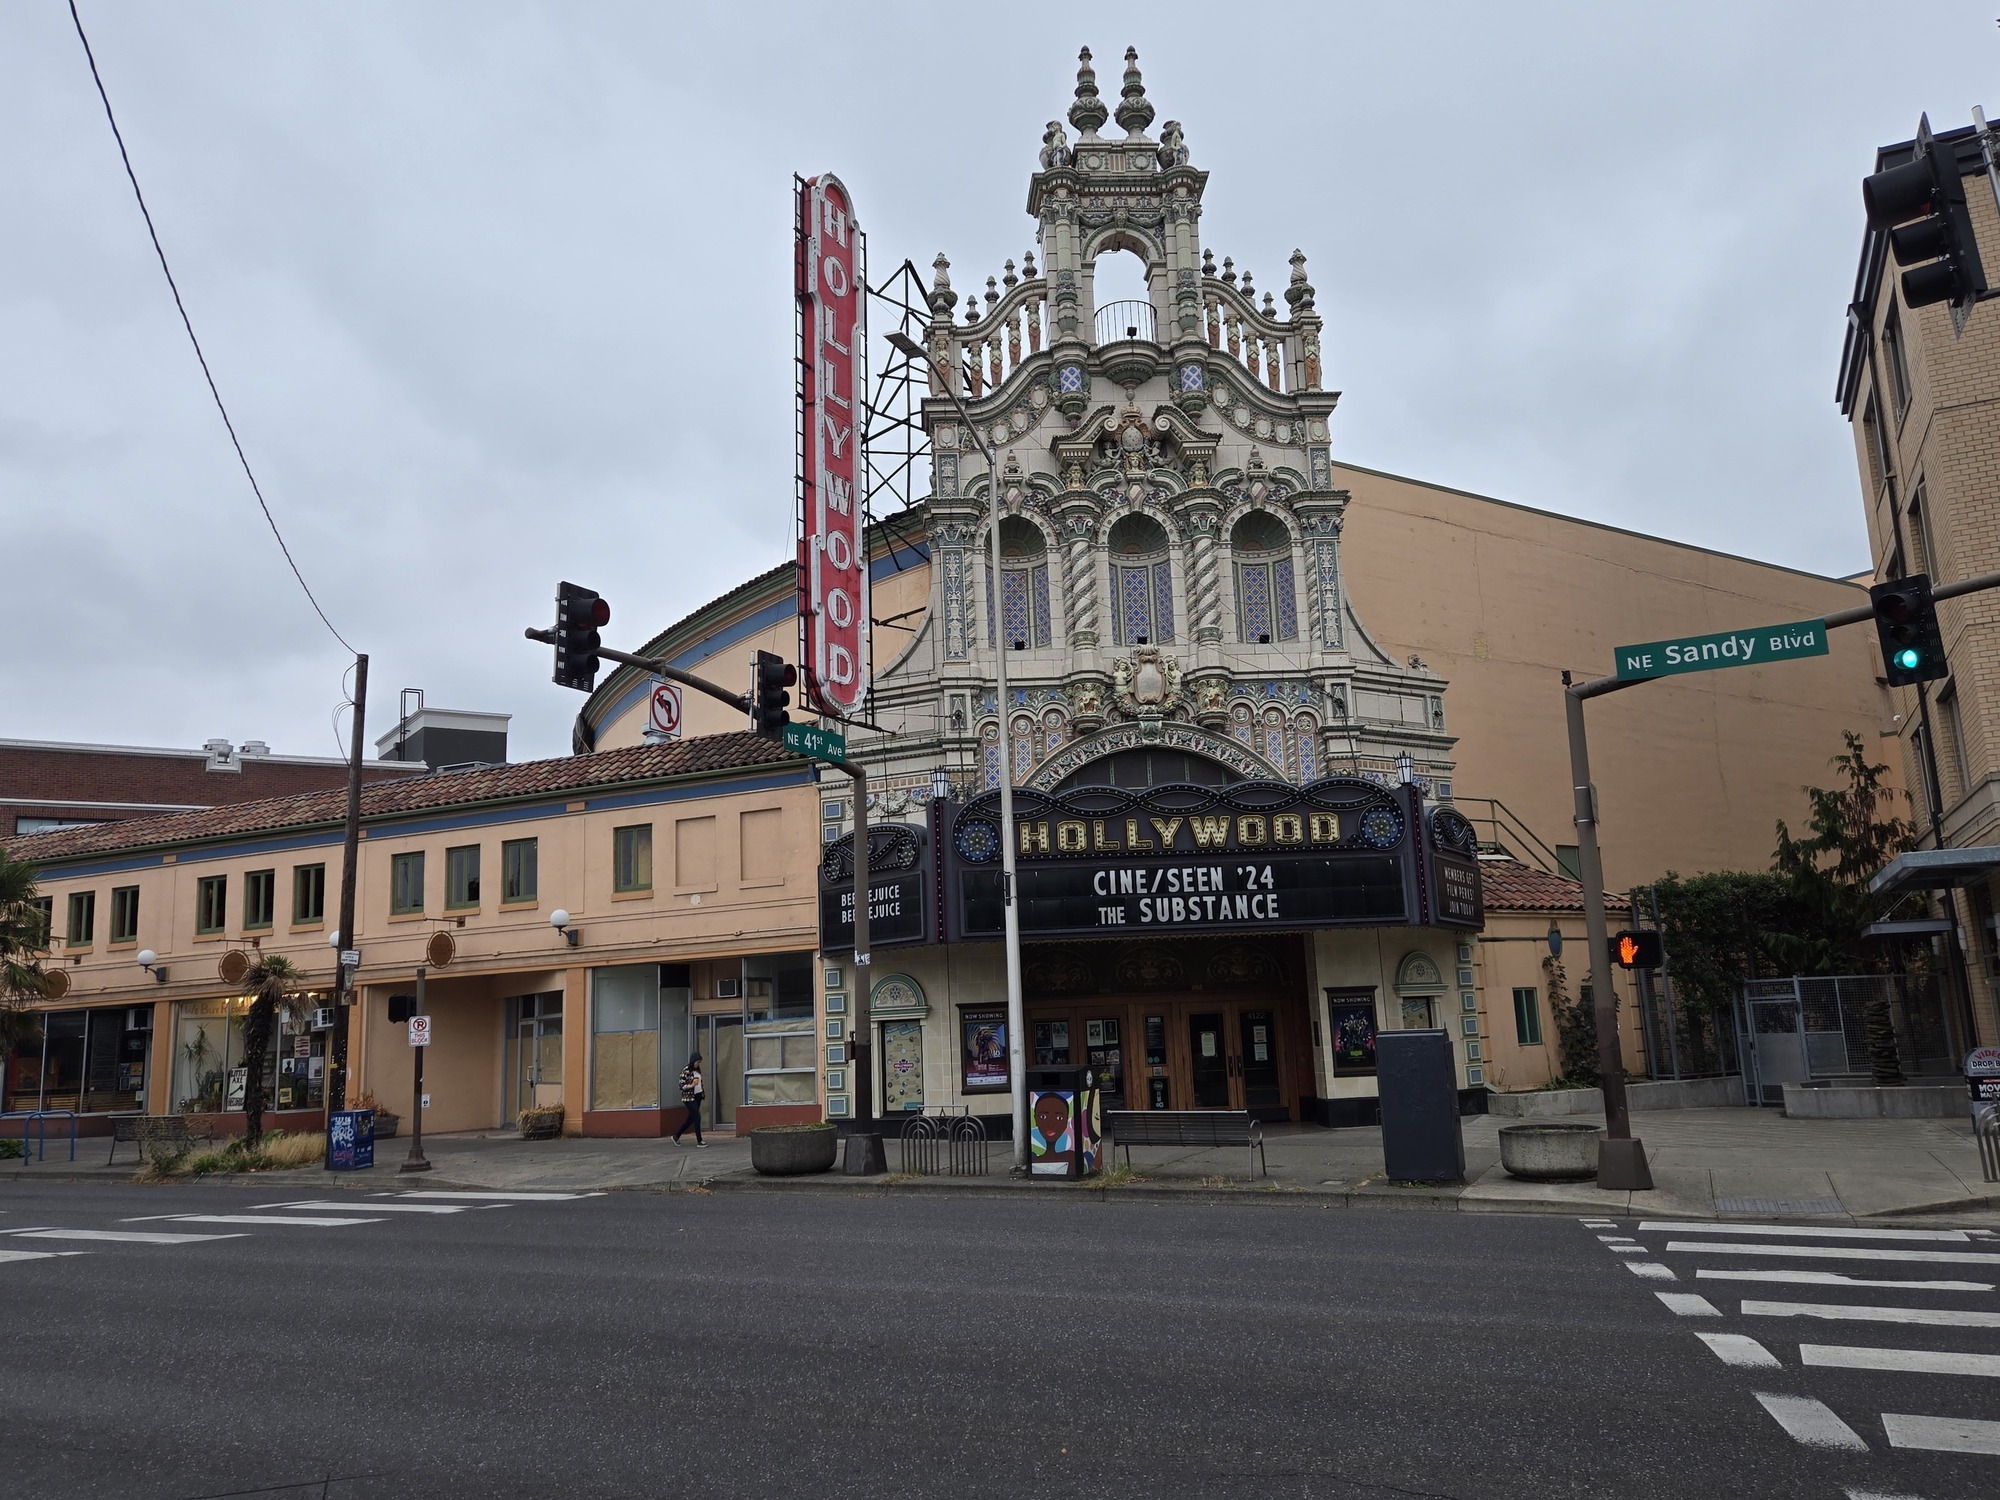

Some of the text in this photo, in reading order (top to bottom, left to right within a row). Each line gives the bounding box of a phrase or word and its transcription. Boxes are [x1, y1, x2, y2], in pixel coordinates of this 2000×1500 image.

[823, 196, 855, 686] HOLLYWOOD
[1627, 632, 1815, 670] NE Sandy Blvd
[787, 733, 842, 757] NE 41st Ave
[1019, 813, 1341, 853] HOLLYWOOD
[1094, 865, 1275, 896] CINE/SEEN '24
[1444, 866, 1475, 885] MEMBERS GET
[841, 885, 900, 907] BEEEJUICE
[1446, 883, 1458, 897] FILM
[841, 902, 901, 923] BEEEJUICE
[1099, 894, 1279, 925] THE SUBSTANCE
[1449, 900, 1475, 916] JOIN TODAY
[1247, 1012, 1266, 1020] 4122
[1972, 1060, 1993, 1068] DROP
